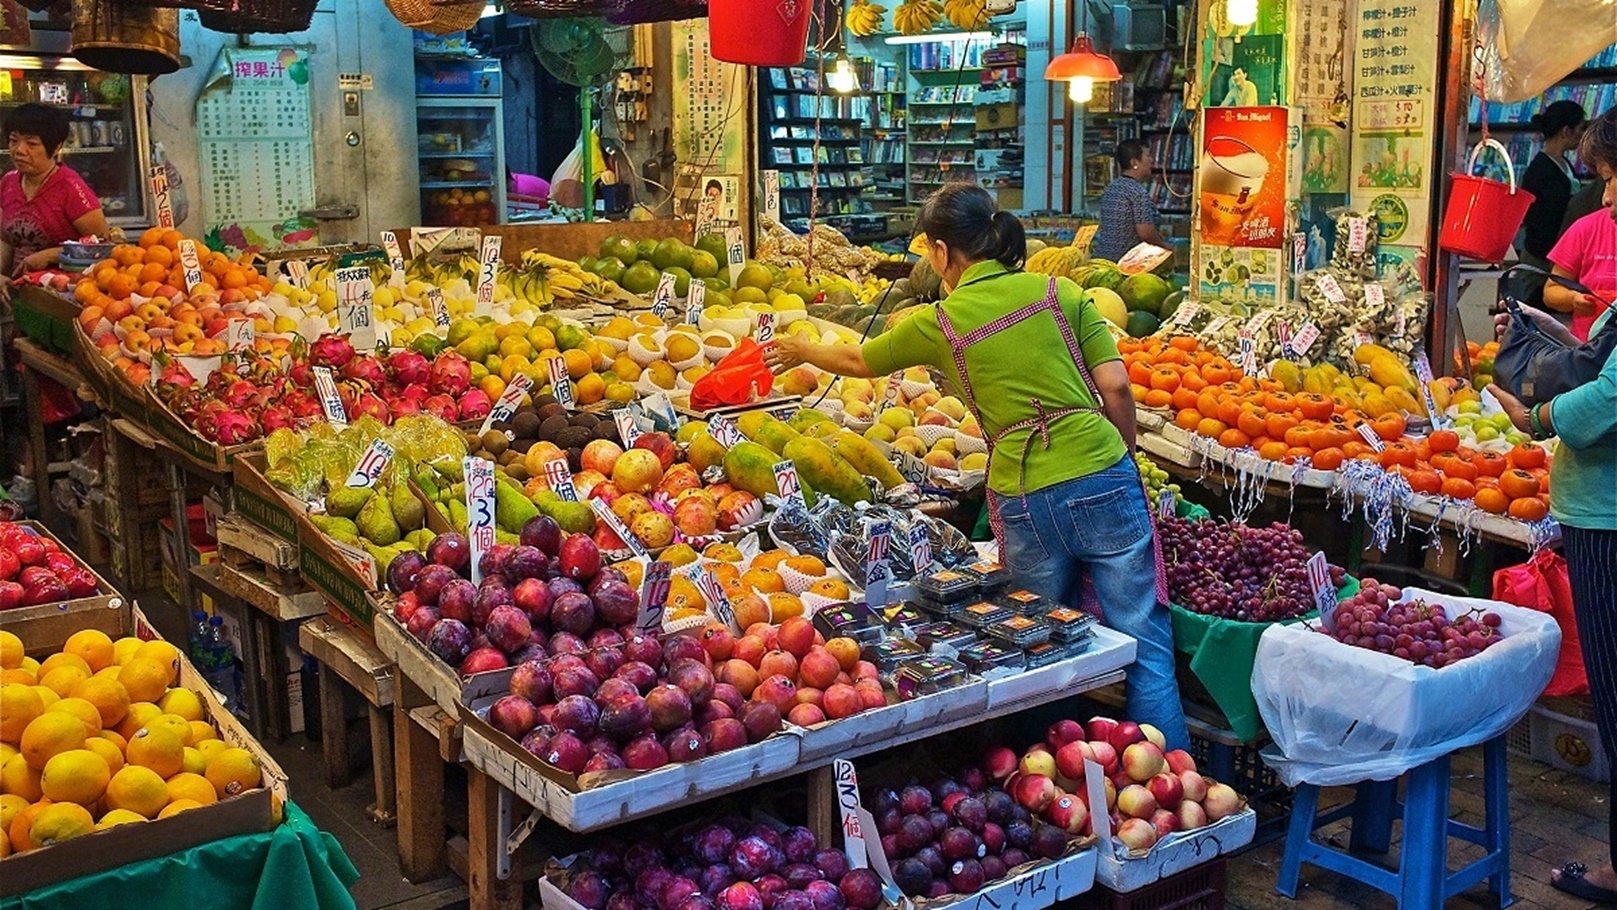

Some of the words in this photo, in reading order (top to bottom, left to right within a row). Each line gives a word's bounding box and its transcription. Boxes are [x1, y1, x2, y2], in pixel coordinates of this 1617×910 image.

[157, 192, 169, 210] 2
[483, 263, 494, 286] 3
[345, 305, 369, 330] 個
[760, 326, 773, 341] 2
[477, 498, 491, 527] 3
[472, 522, 494, 553] 個
